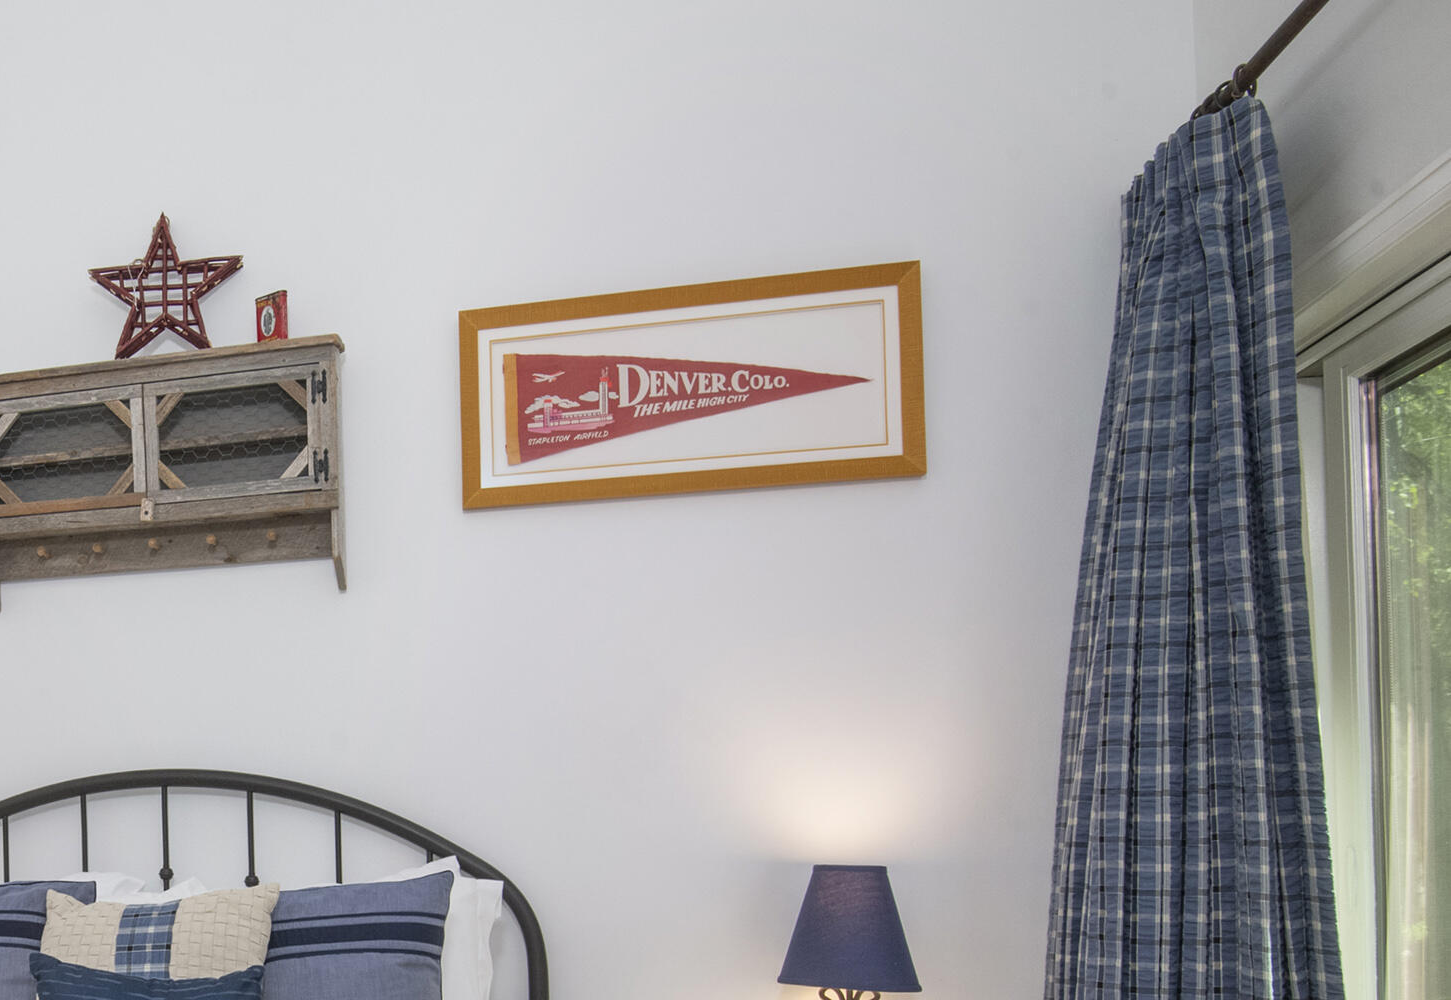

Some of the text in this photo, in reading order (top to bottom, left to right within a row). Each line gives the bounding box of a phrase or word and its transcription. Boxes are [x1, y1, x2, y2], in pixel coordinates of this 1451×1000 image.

[633, 393, 750, 418] THE MILE HIGH CITY
[527, 430, 610, 446] STAPLETON AIRFIELD
